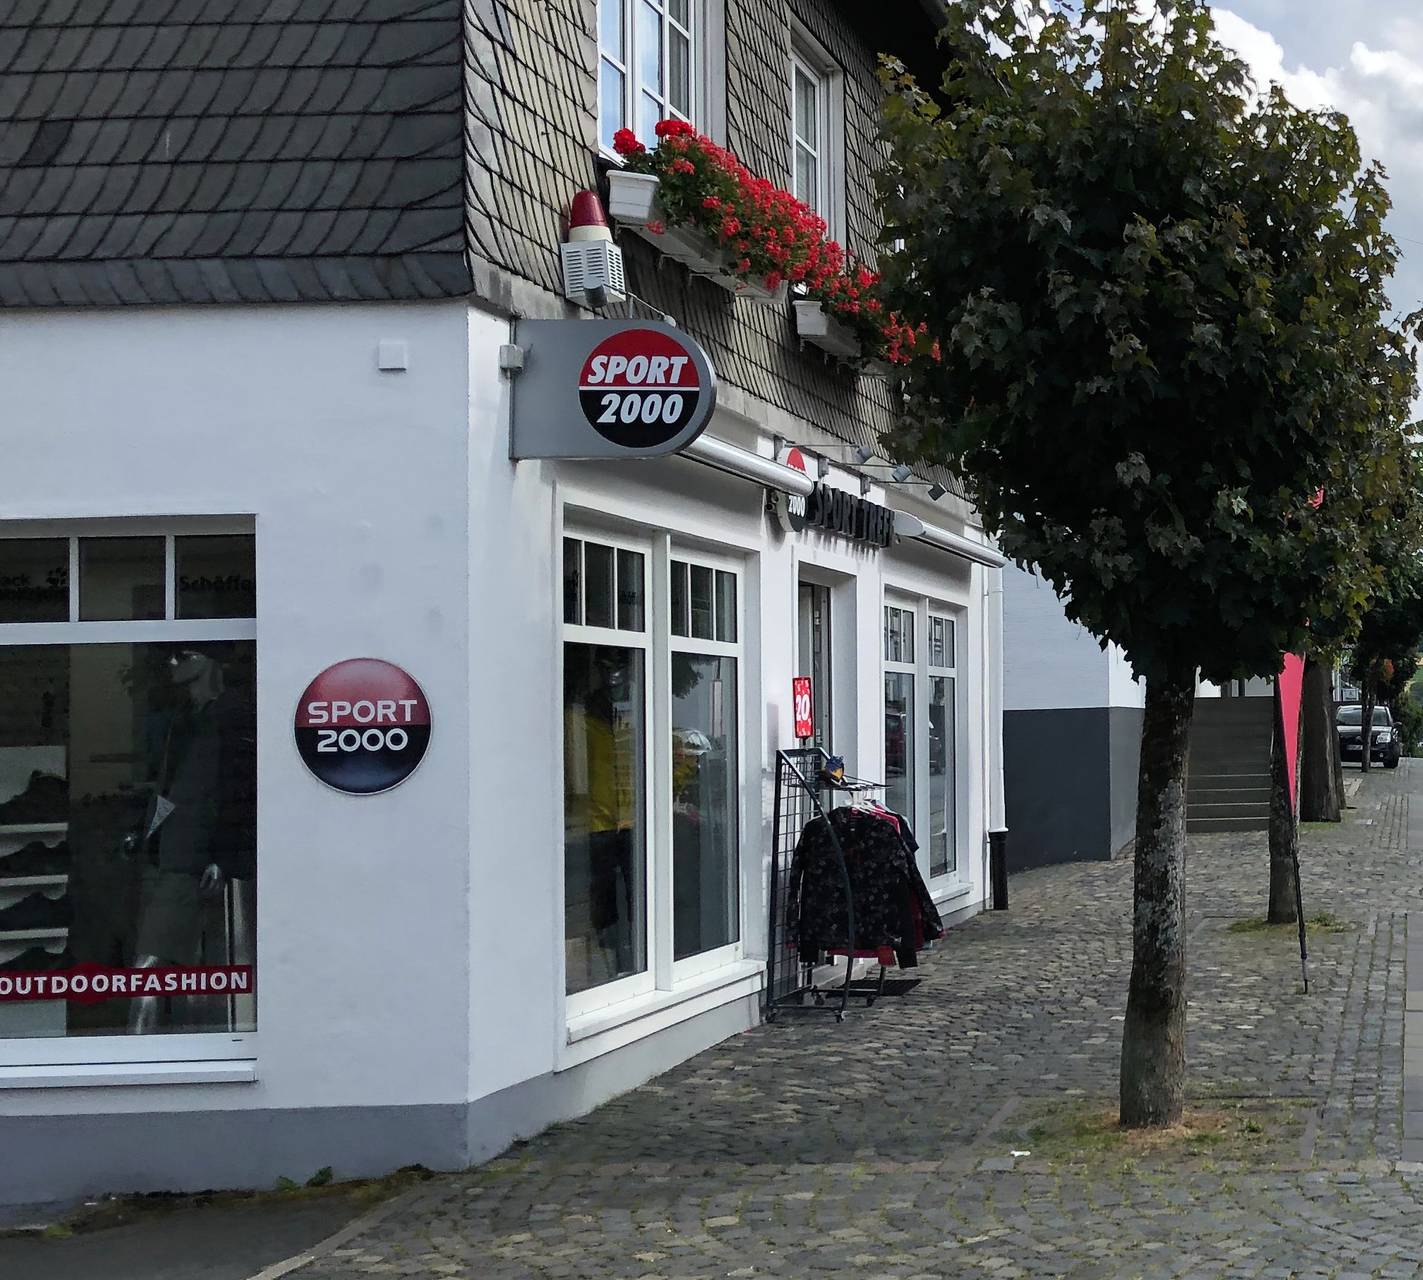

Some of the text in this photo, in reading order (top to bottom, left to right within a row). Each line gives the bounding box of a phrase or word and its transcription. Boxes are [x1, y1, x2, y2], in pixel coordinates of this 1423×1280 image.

[587, 355, 688, 384] SPORT
[596, 393, 684, 424] 2000
[308, 699, 417, 724] SPORT
[317, 728, 408, 752] 2000
[0, 972, 247, 995] OUTDOORFASHION
